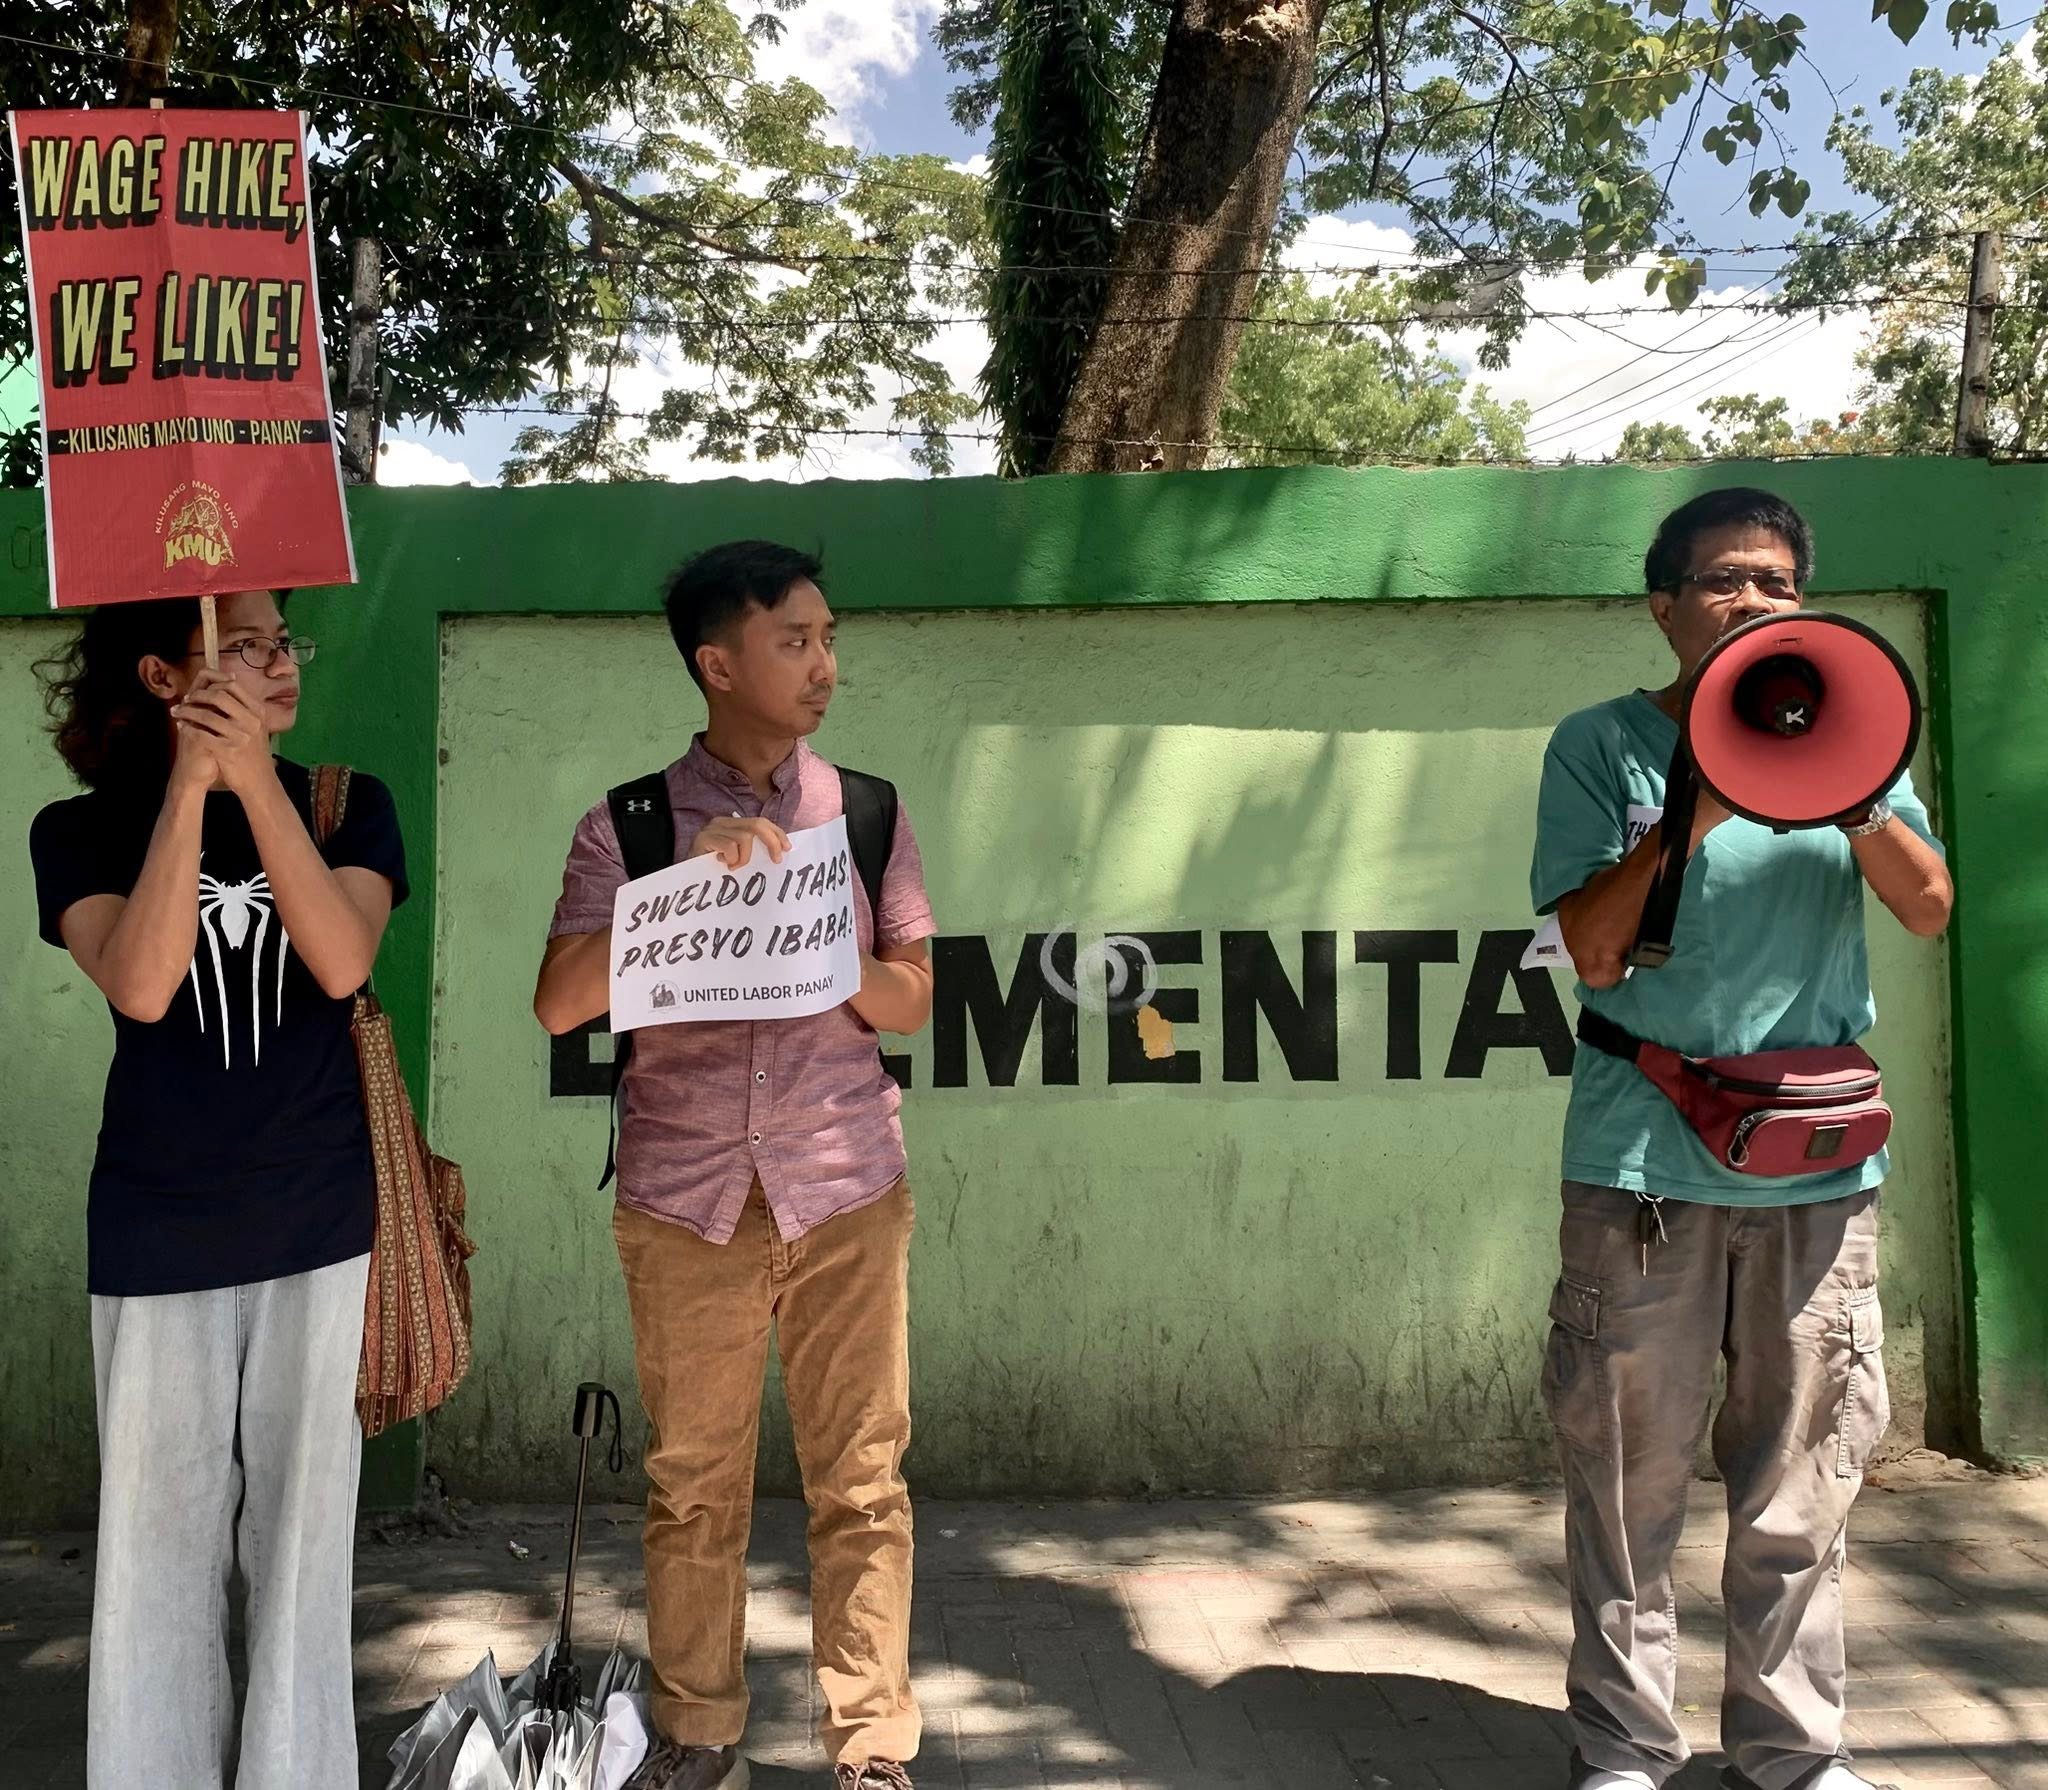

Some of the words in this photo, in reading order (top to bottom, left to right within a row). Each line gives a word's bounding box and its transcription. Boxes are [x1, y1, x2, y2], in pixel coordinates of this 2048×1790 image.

[28, 136, 166, 230] WAGE
[177, 138, 306, 242] HIKE,
[52, 276, 141, 387] WE
[153, 271, 304, 380] LIKE!
[153, 417, 198, 447] MAYO
[202, 418, 235, 444] UNO
[155, 482, 187, 534] KILUSANG
[191, 480, 221, 499] MAYO
[223, 502, 239, 529] UNO
[165, 533, 221, 569] KMU
[625, 871, 767, 933] SWELDO
[777, 849, 850, 903] ITAAS
[616, 926, 753, 978] PRESYO
[766, 905, 853, 957] IBABA!
[684, 987, 739, 1003] UNITED
[743, 985, 792, 1000] LABOR
[796, 974, 834, 997] PANAY
